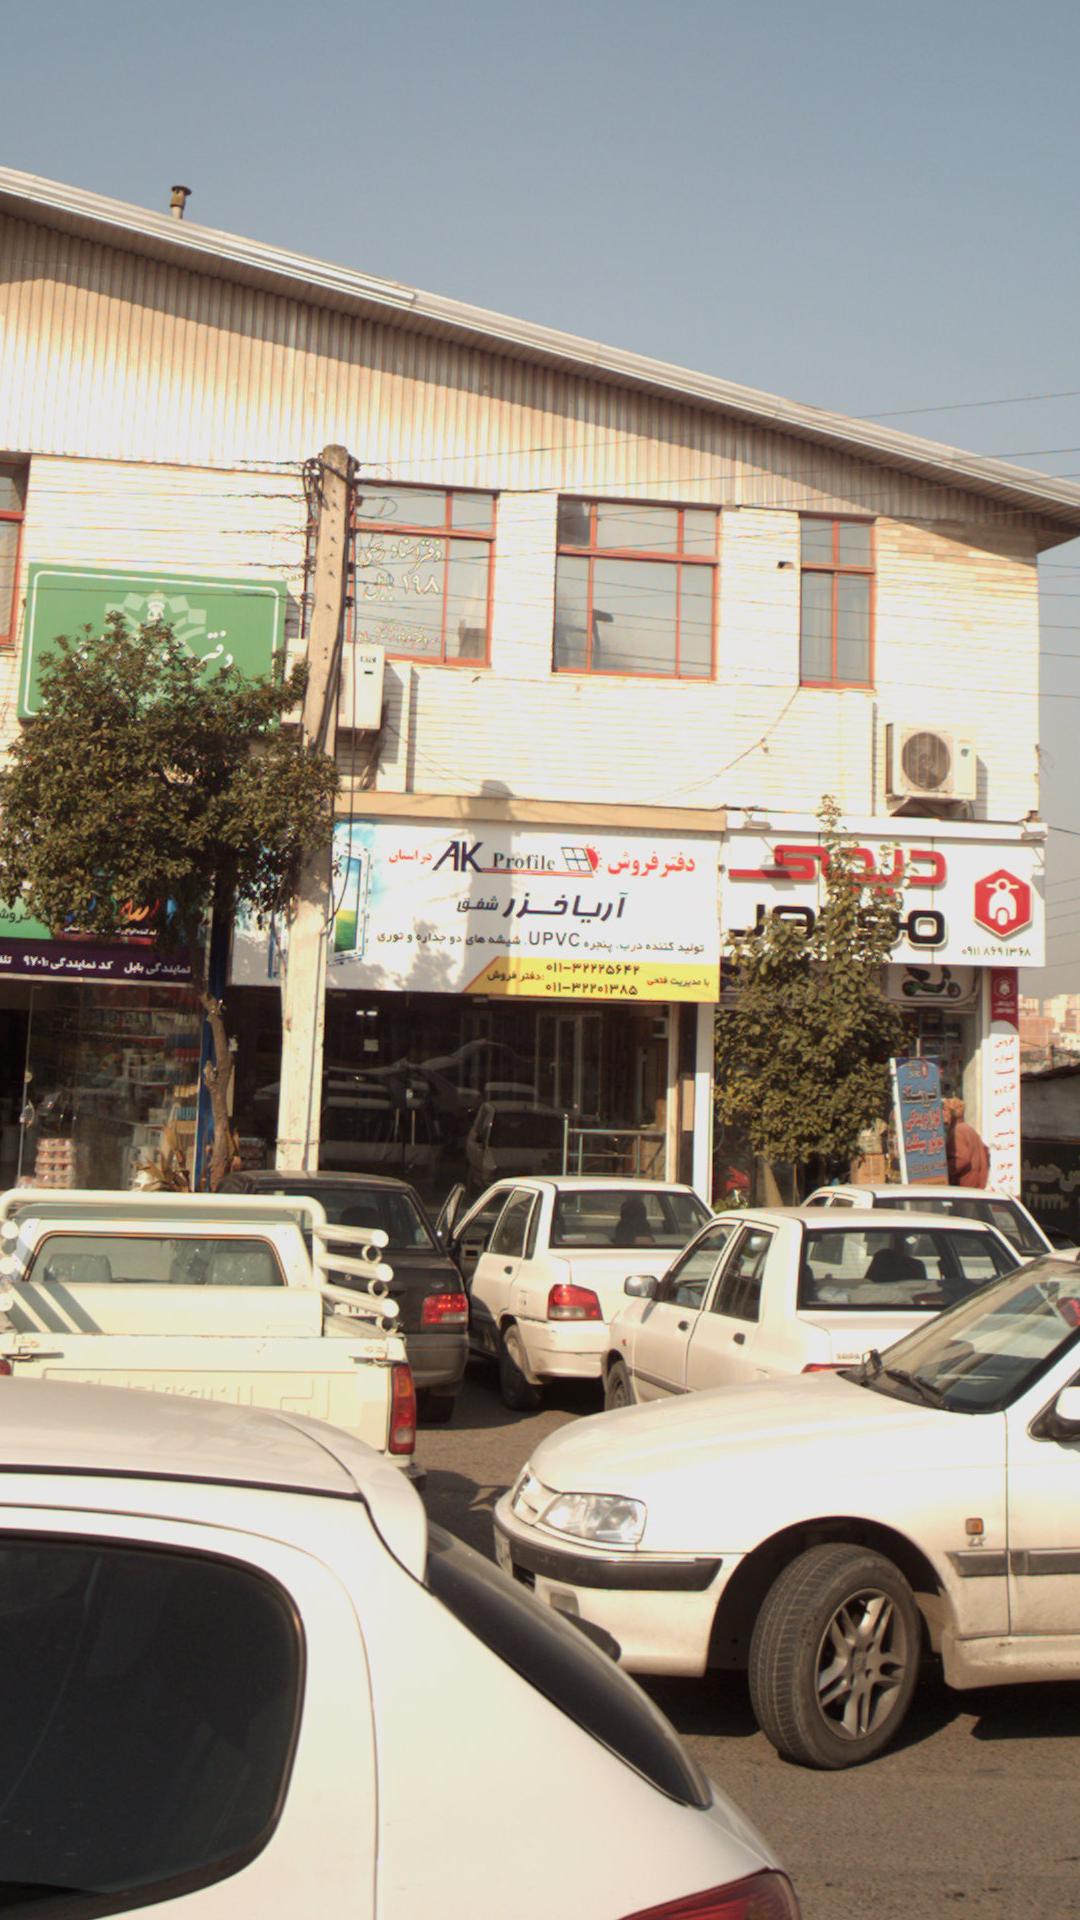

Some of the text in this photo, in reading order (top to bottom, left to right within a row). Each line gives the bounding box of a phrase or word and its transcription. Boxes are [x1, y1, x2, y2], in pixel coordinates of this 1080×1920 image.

[419, 850, 434, 865] در
[432, 840, 556, 873] AK Profile
[607, 850, 697, 878] دفتر فروش
[456, 896, 500, 913] شفق
[98, 960, 115, 971] کد
